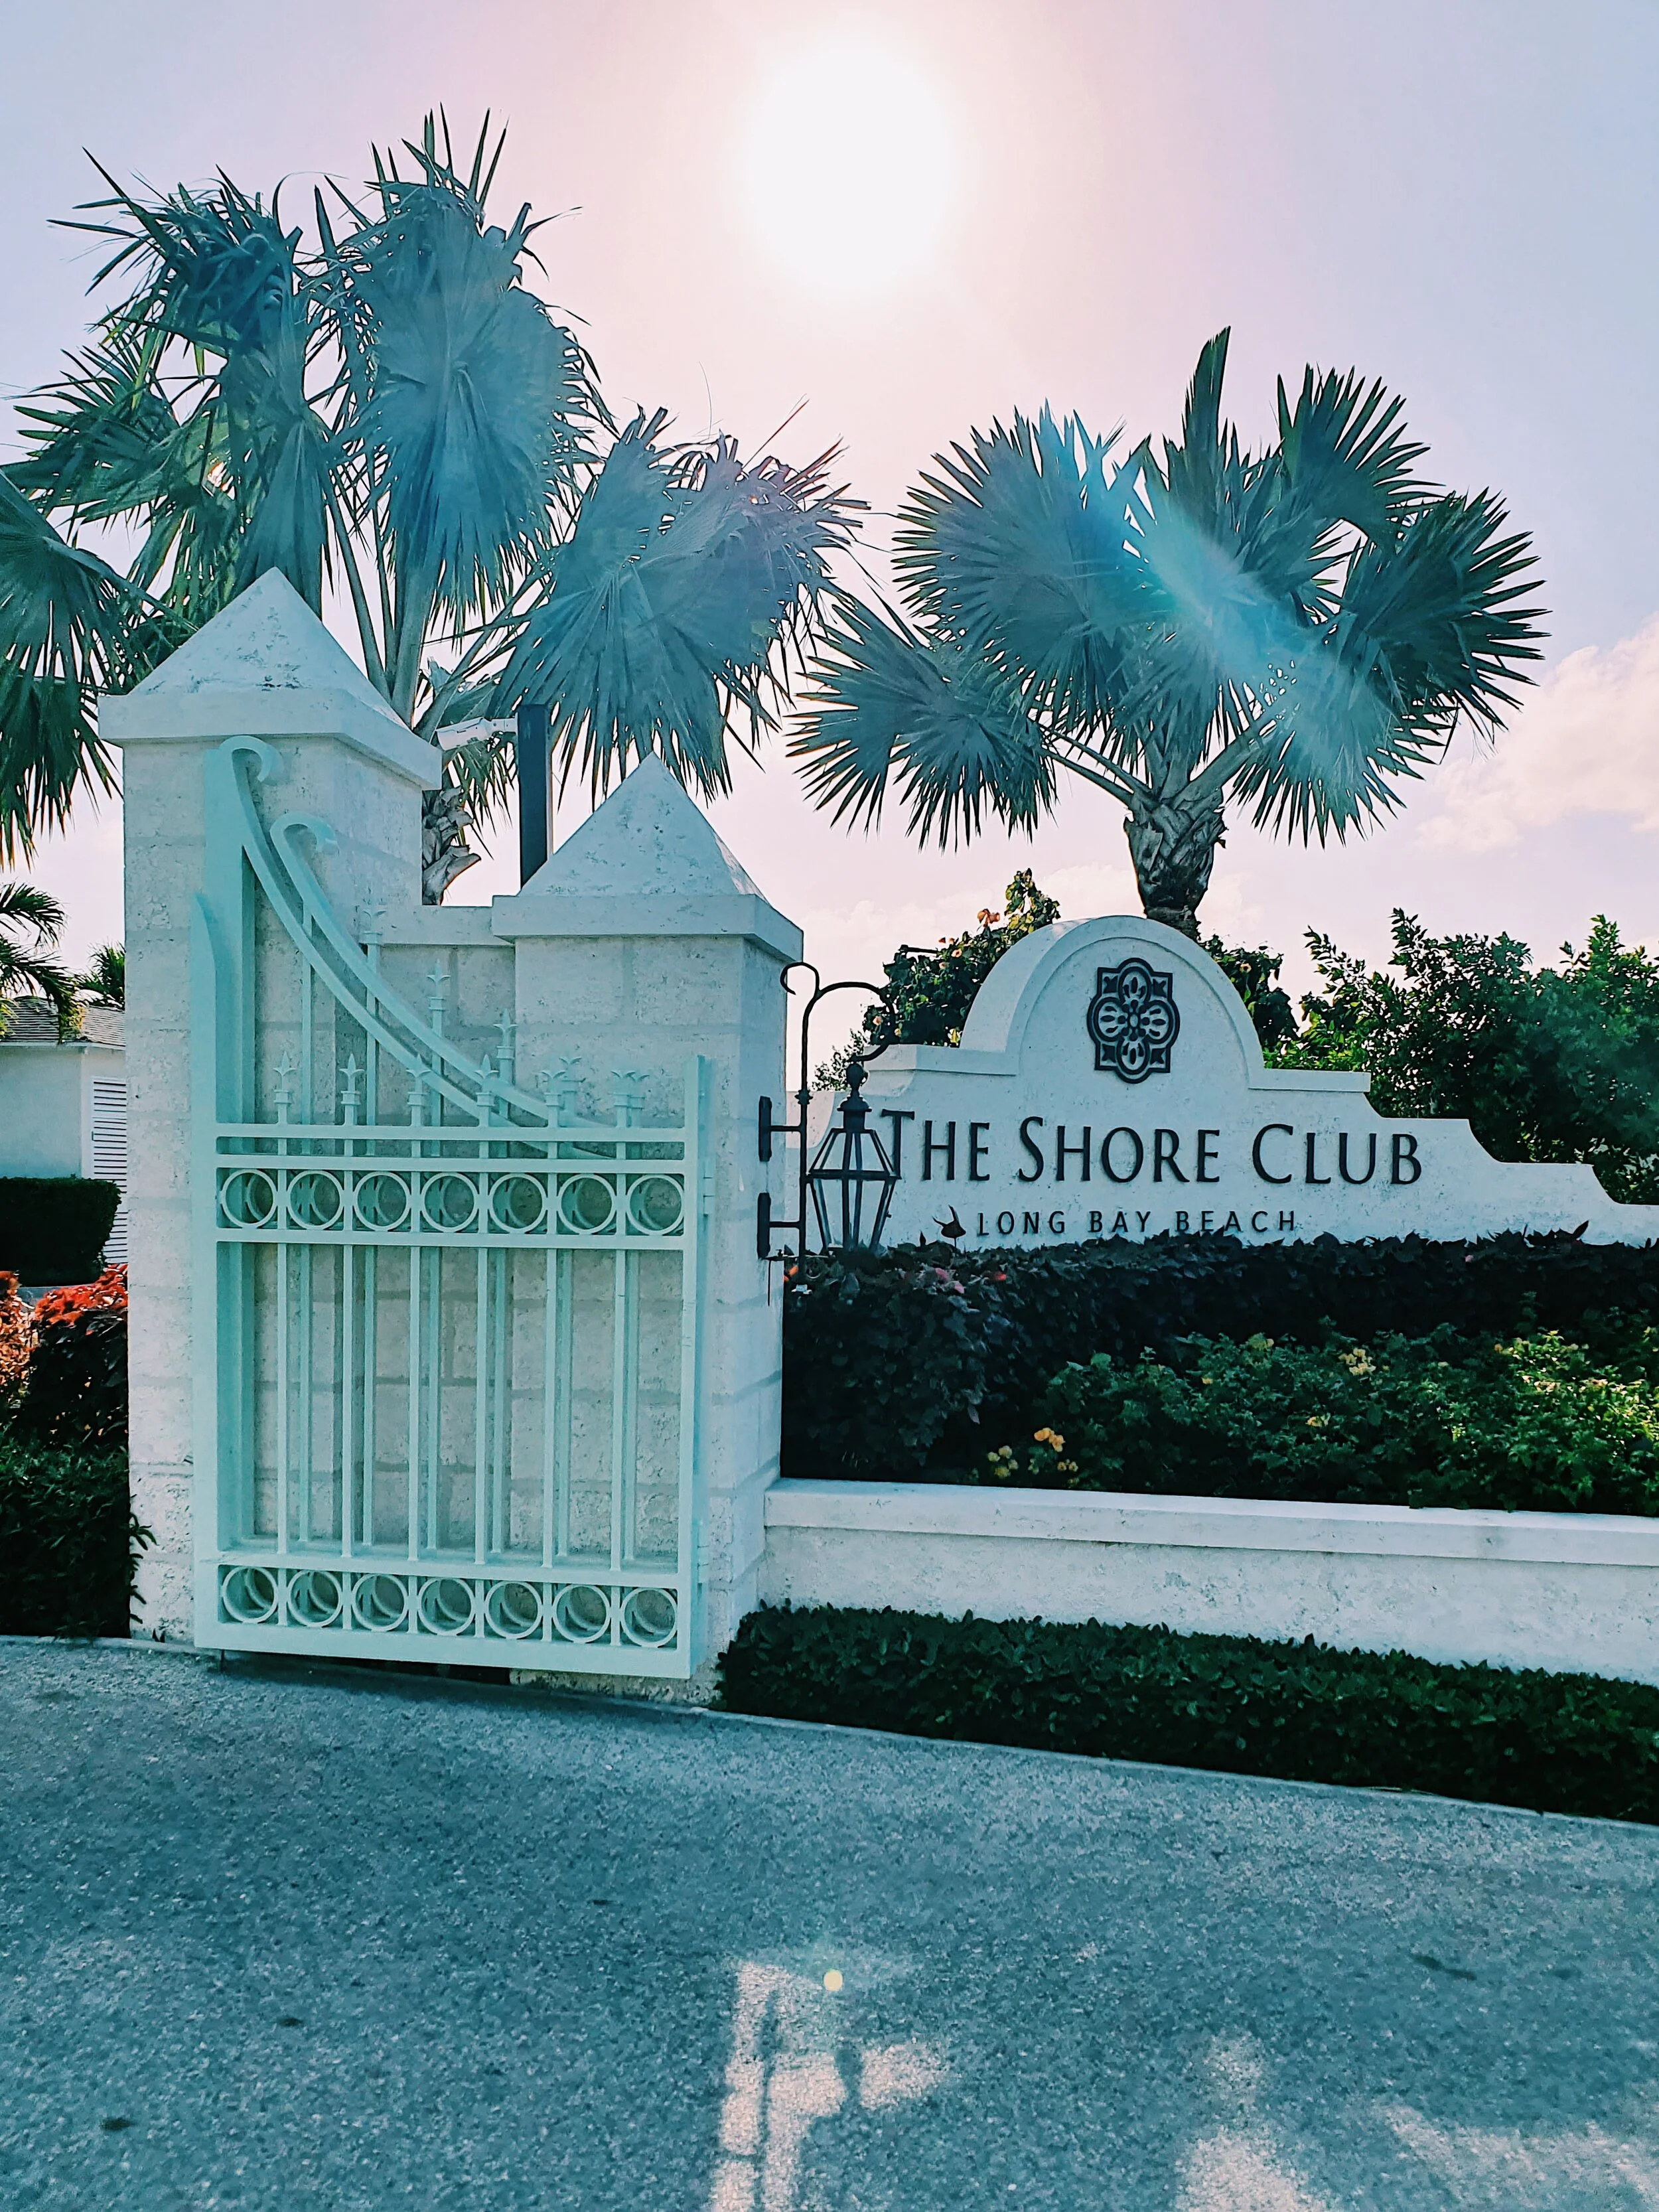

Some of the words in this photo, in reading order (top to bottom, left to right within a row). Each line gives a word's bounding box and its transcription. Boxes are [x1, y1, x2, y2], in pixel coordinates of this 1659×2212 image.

[881, 1109, 990, 1181] THE
[1019, 1116, 1220, 1183] SHORE
[1252, 1124, 1421, 1185] CLUB
[977, 1211, 1065, 1236] LONG
[1089, 1211, 1151, 1232] BAY
[1175, 1211, 1294, 1232] BEACH
